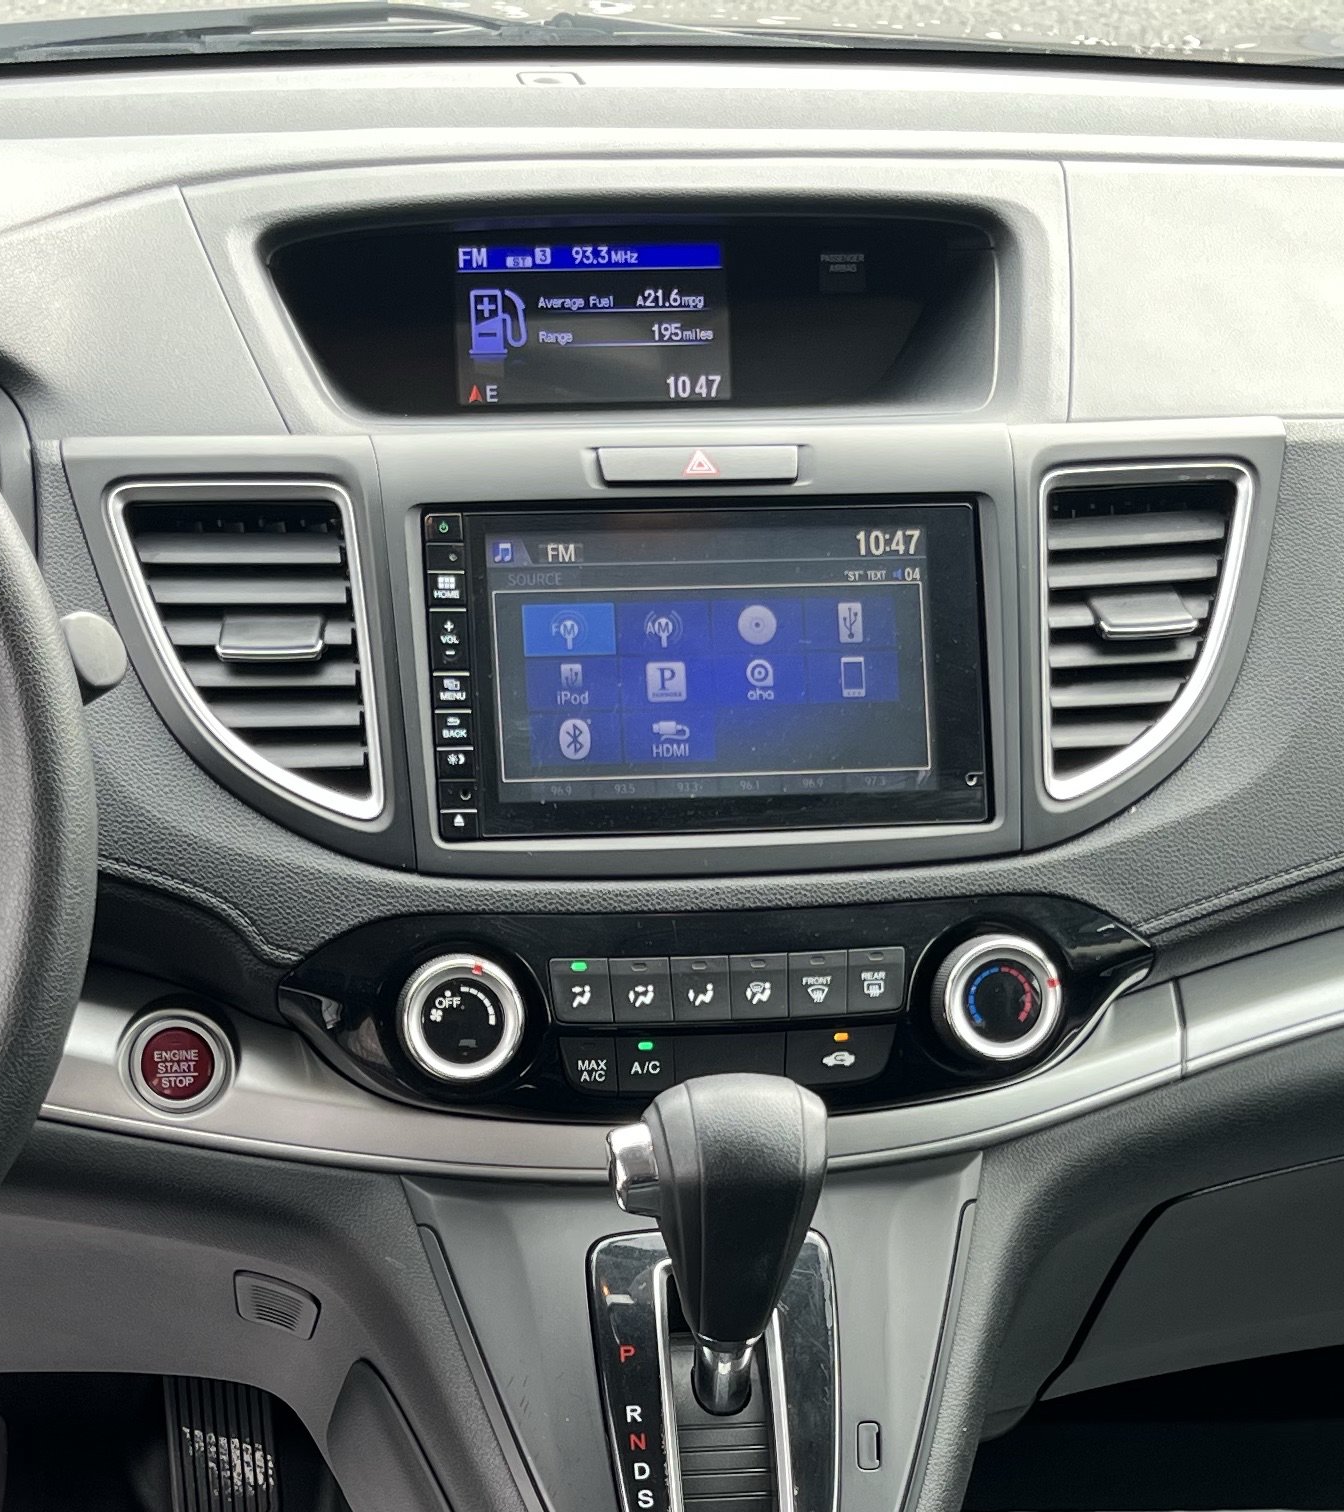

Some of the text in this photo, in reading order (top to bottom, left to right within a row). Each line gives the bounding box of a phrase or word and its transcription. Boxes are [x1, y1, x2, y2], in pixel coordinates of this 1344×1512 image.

[458, 247, 488, 268] FM
[571, 246, 609, 265] 93.3
[610, 250, 638, 264] MHz
[537, 296, 585, 311] Average
[589, 295, 614, 308] Fuel
[538, 330, 573, 346] Range
[485, 384, 498, 402] E
[547, 529, 921, 562] FM 10:47
[507, 572, 563, 586] SOURCE
[866, 570, 887, 580] TEXT
[904, 567, 921, 581] 04
[433, 589, 460, 600] HOME
[440, 634, 460, 644] VOL
[439, 691, 466, 701] MENU
[557, 691, 589, 705] iPod
[747, 689, 775, 700] aha
[442, 729, 467, 739] BACK
[652, 743, 689, 757] HDMI
[802, 975, 832, 986] FRONT
[861, 971, 886, 980] REAR
[435, 996, 461, 1009] OFF
[153, 1049, 199, 1061] ENGINE
[157, 1061, 197, 1073] START
[577, 1059, 607, 1071] MAX
[630, 1061, 661, 1075] A/C
[161, 1076, 194, 1088] STOP
[580, 1071, 606, 1082] A/C
[619, 1345, 635, 1363] P
[626, 1405, 641, 1423] R
[629, 1433, 646, 1451] N
[633, 1462, 650, 1481] D
[637, 1490, 654, 1509] S
